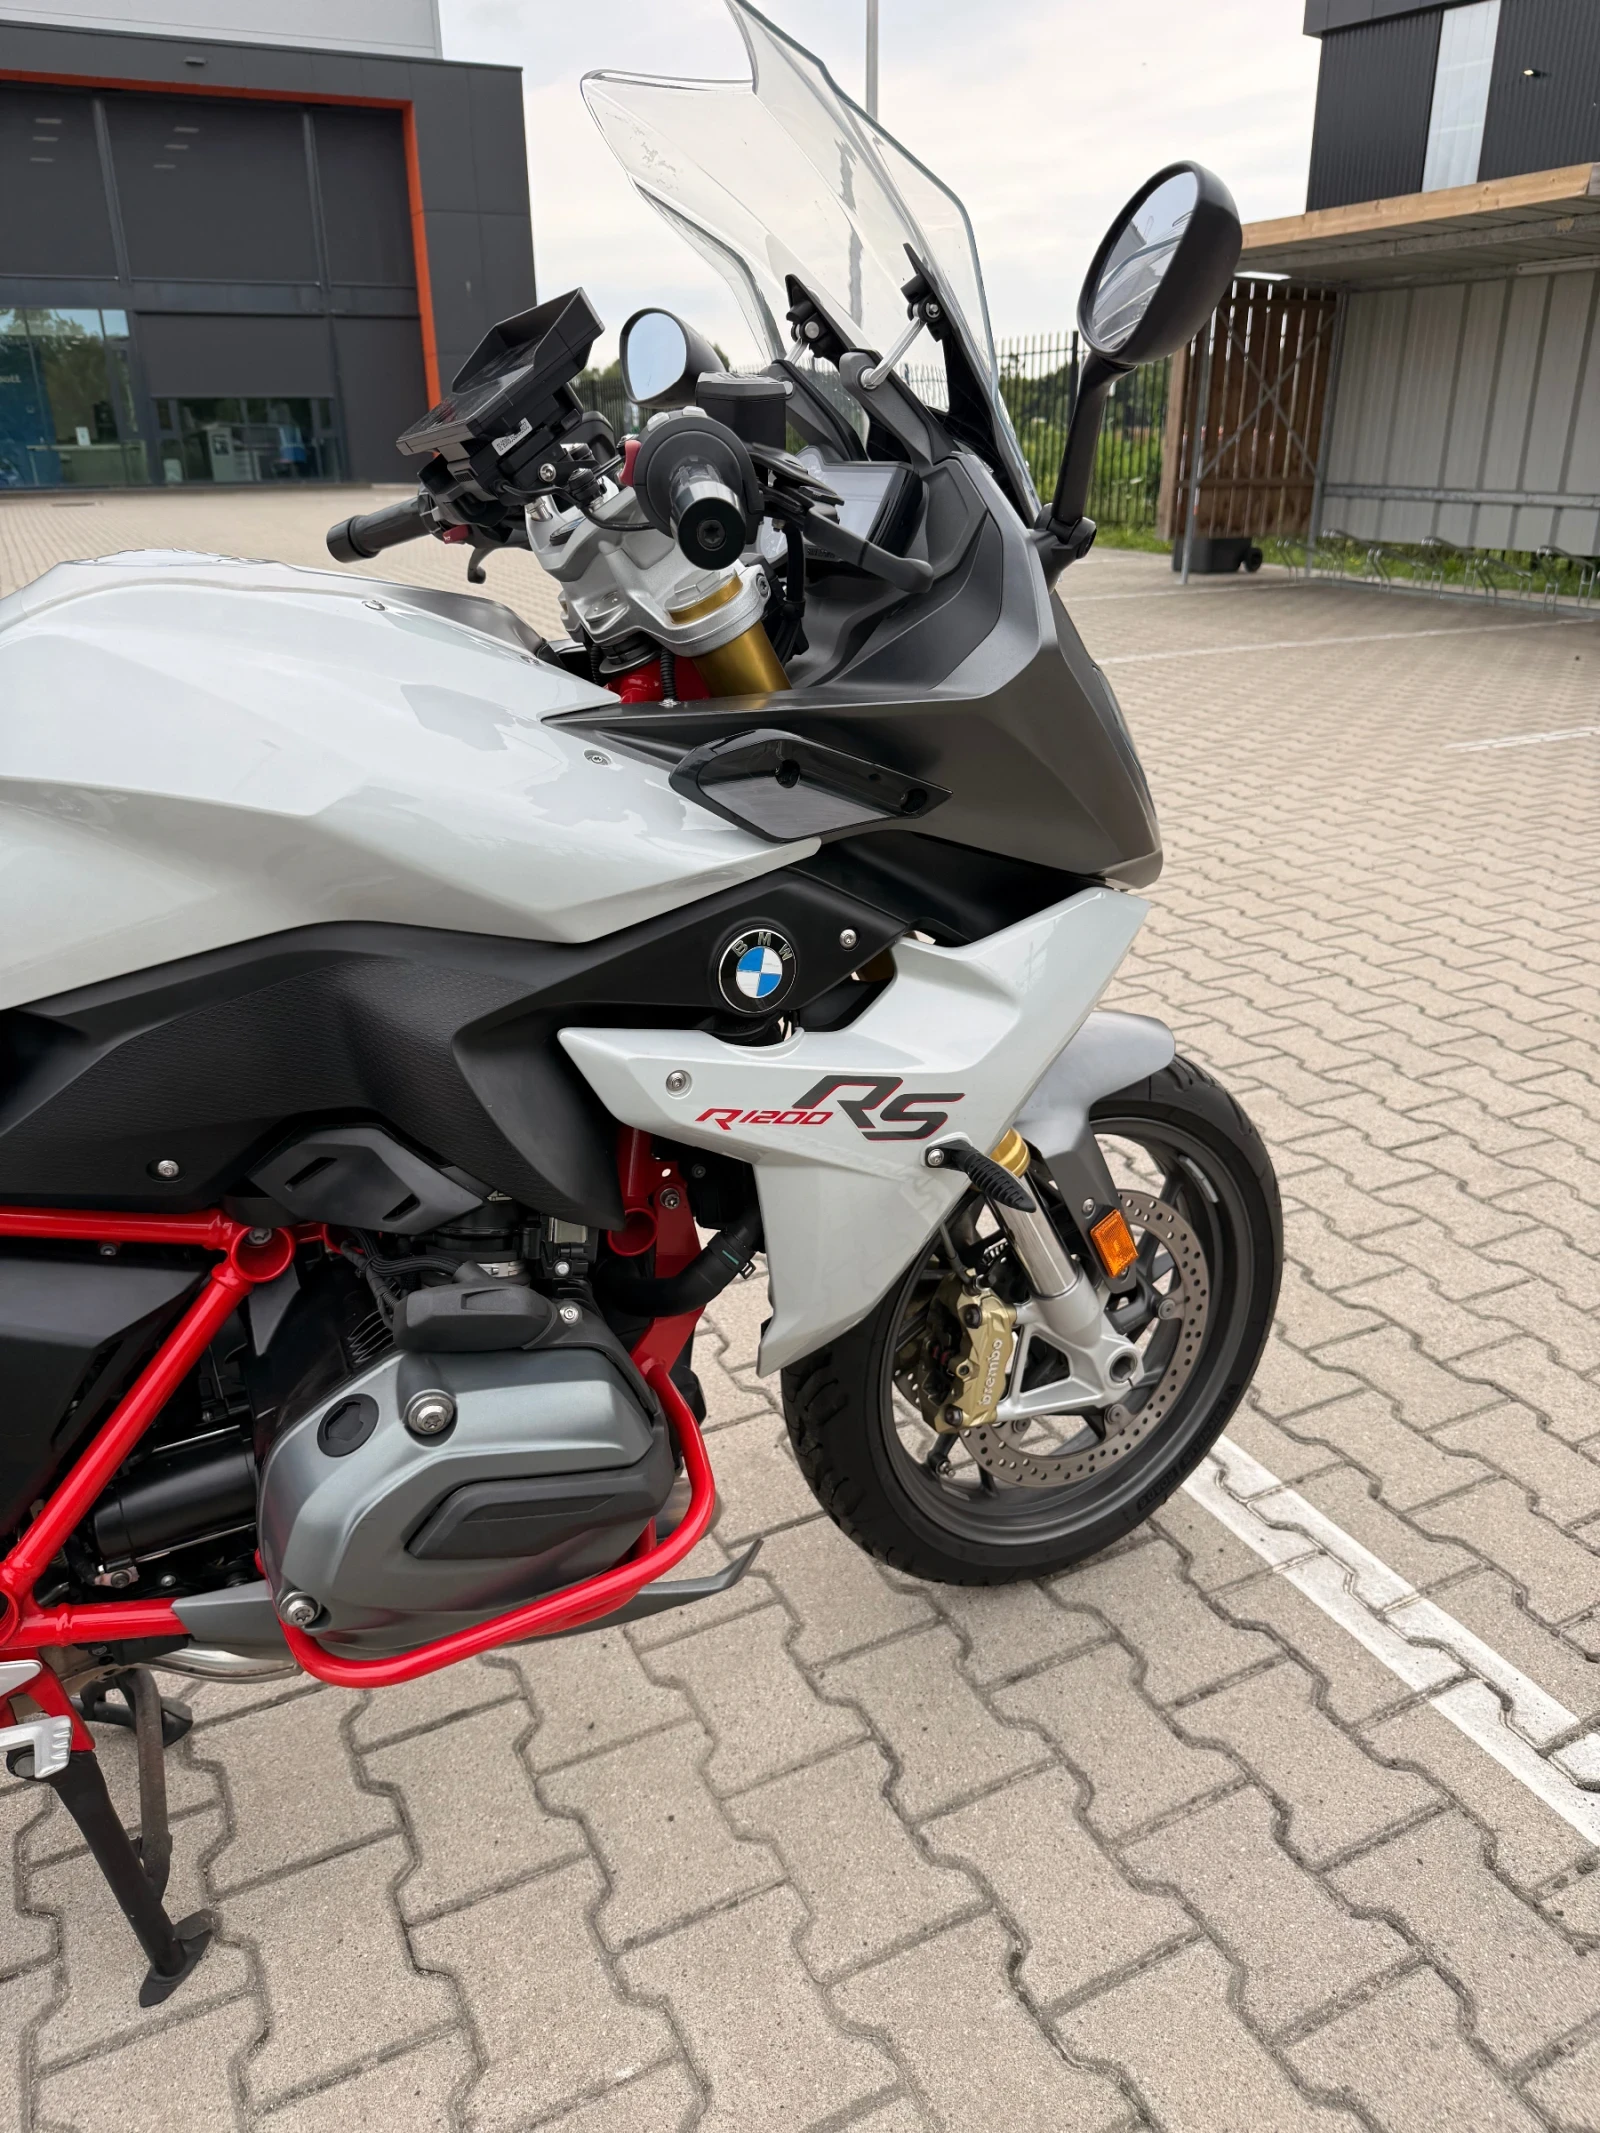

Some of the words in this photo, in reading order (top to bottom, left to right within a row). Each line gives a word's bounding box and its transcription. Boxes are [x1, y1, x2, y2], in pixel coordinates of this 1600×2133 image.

[731, 931, 793, 961] BMW
[791, 1074, 966, 1141] RS
[978, 1339, 1003, 1405] brembo
